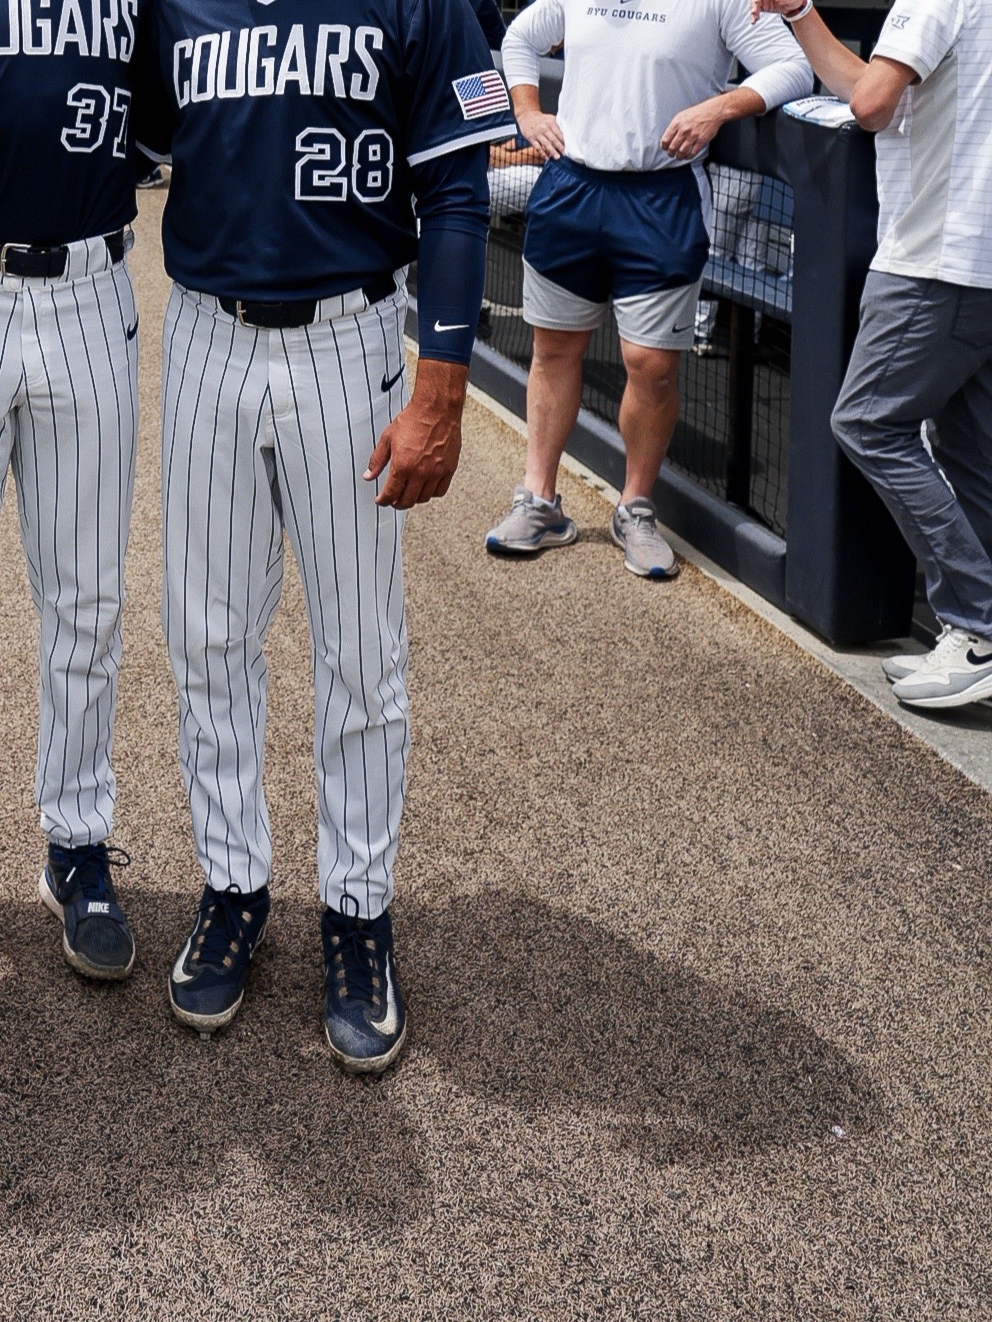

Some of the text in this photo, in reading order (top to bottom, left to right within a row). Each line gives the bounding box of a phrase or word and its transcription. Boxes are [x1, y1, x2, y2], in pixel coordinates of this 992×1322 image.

[586, 7, 667, 23] BYU COUGARS
[173, 24, 384, 109] COUGARS
[60, 82, 132, 159] 37
[294, 126, 394, 203] 28
[87, 901, 110, 914] NIKE
